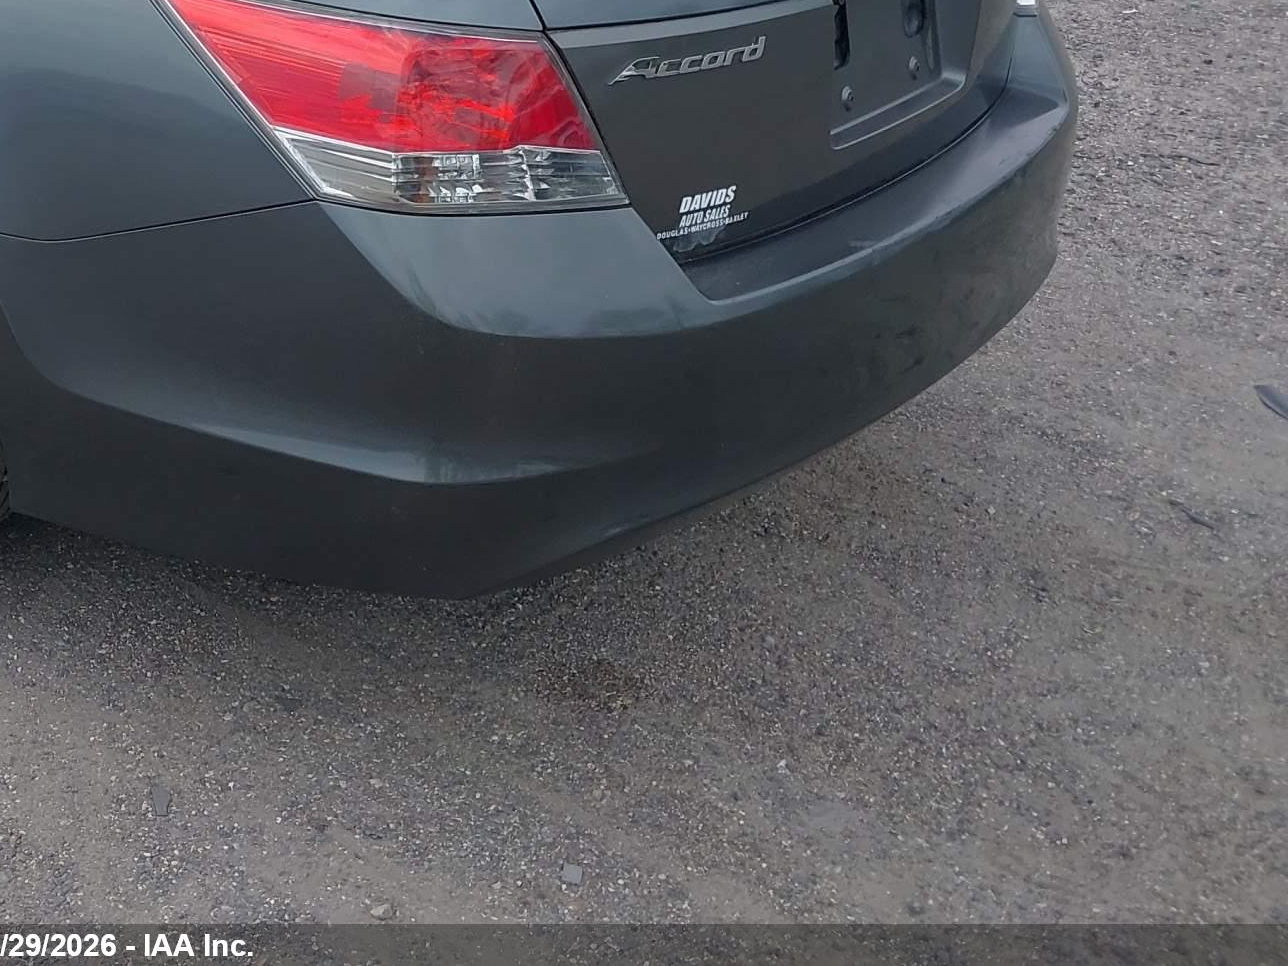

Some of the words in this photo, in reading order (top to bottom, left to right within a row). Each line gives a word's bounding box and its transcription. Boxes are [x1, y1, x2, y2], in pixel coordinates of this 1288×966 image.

[608, 35, 766, 86] Accord
[679, 185, 737, 214] DAVIDS
[679, 211, 704, 228] AUTO
[704, 204, 731, 223] SALES
